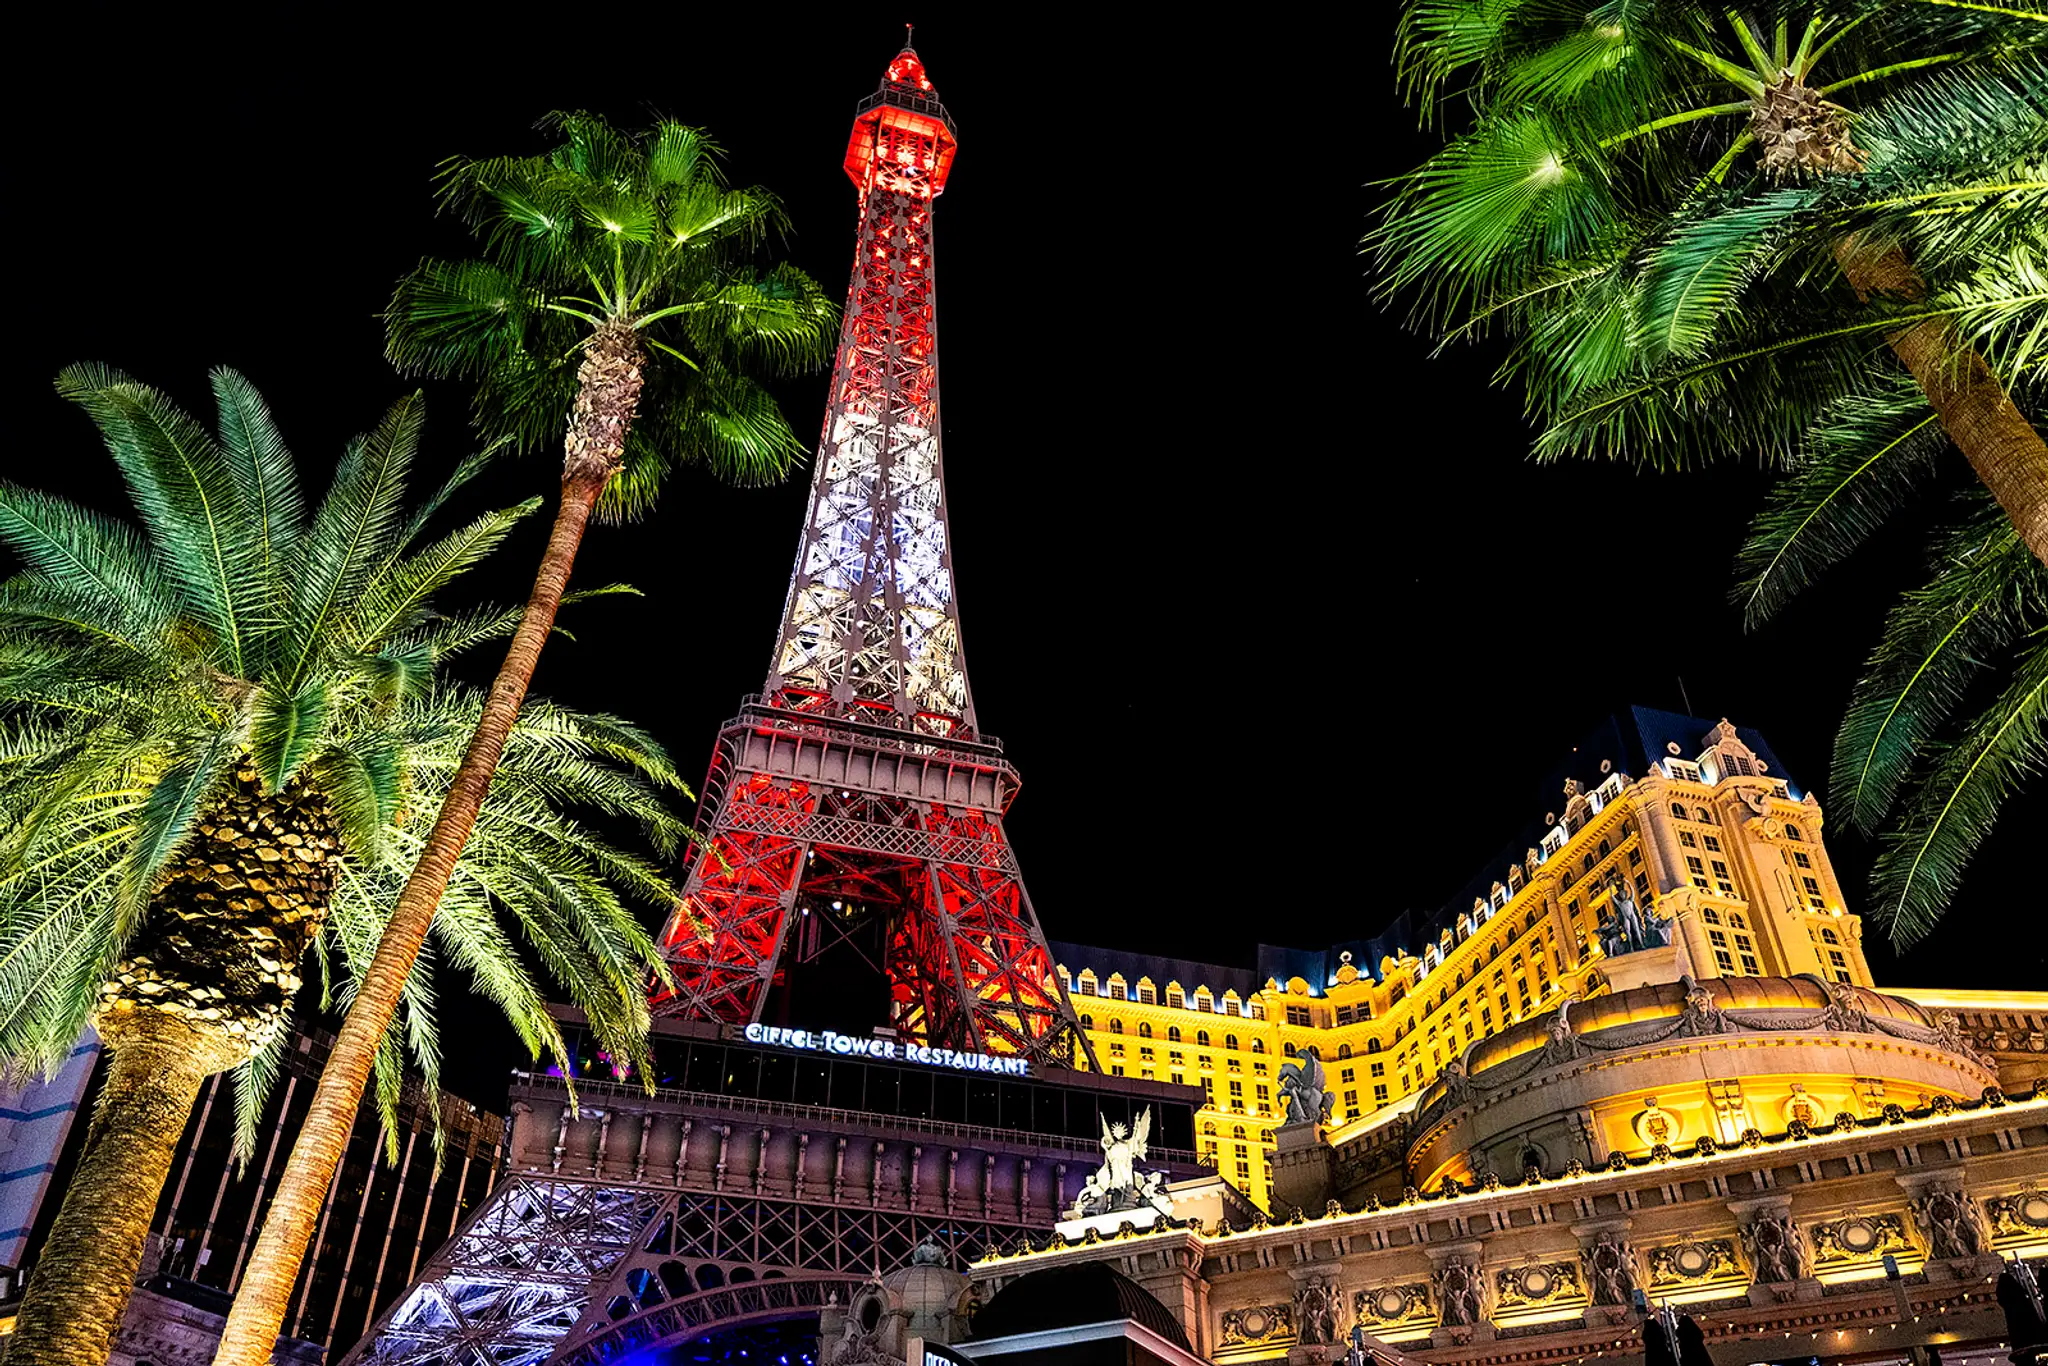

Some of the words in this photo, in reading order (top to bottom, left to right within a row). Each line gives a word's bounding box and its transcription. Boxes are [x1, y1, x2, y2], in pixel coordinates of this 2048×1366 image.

[745, 1022, 818, 1050] EIFFEL
[821, 1030, 895, 1059] TOWER
[905, 1042, 1029, 1077] RESTAURANT
